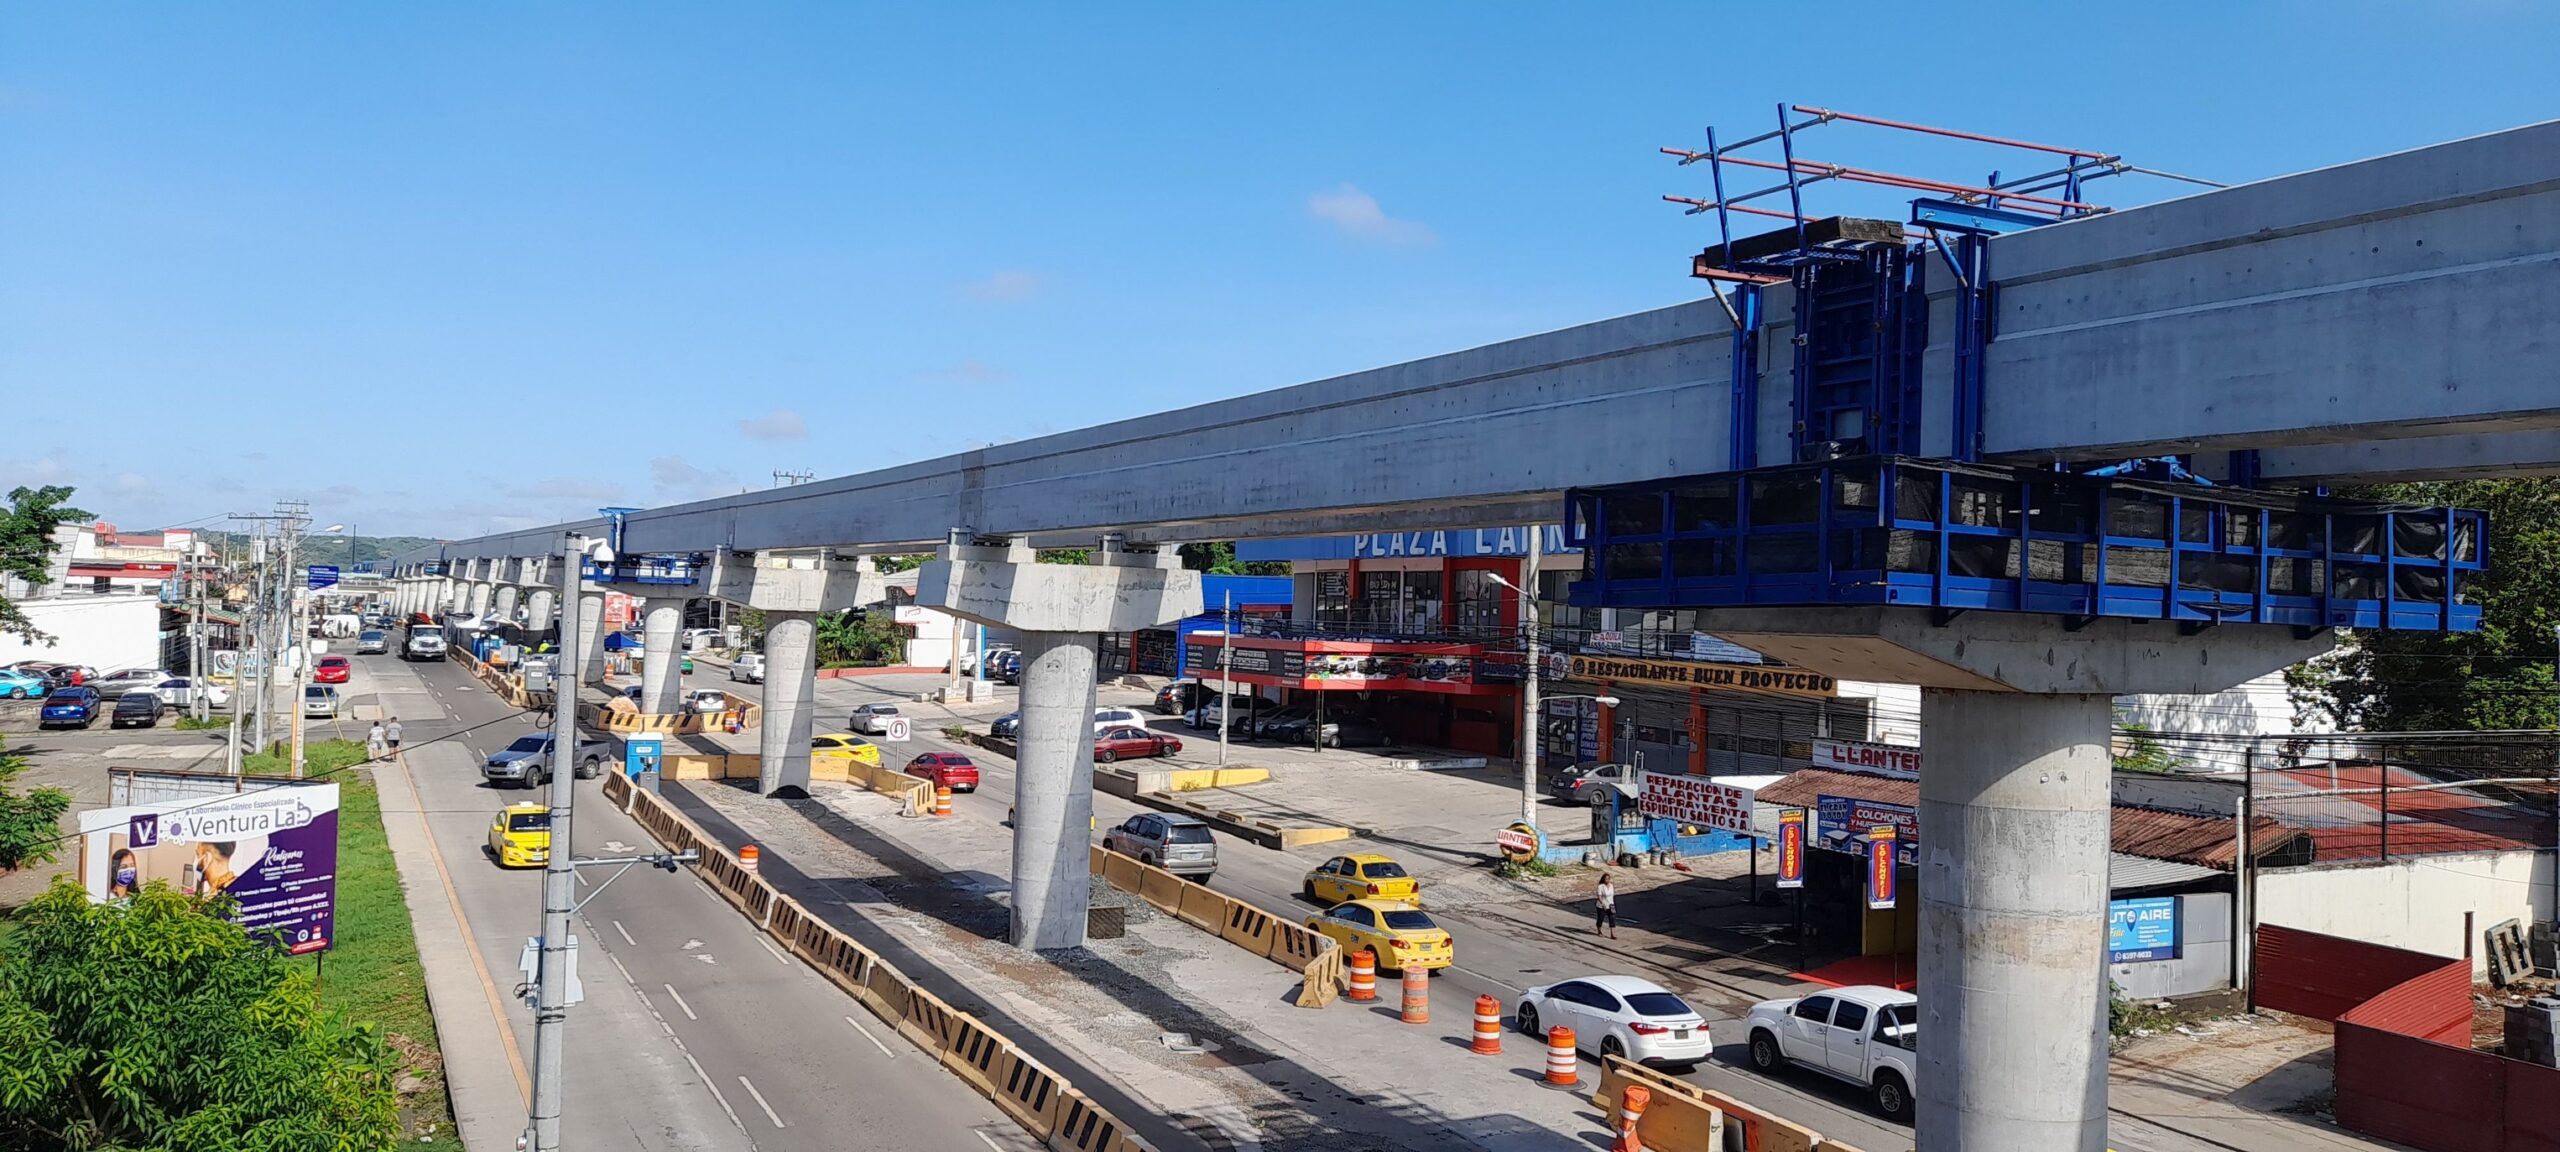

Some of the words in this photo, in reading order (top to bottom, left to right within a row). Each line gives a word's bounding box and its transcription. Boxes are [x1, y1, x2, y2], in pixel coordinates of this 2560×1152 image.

[1354, 530, 1448, 557] PLAZA
[1475, 524, 1586, 554] LAN
[1587, 661, 1687, 682] RESTAURANTE
[1694, 668, 1739, 685] BUEN
[1740, 671, 1833, 692] PROVECHO
[1646, 774, 1721, 795] REPARACION
[1724, 788, 1742, 799] DE
[1648, 785, 1739, 807] LLANTAS
[189, 812, 269, 837] Ventura
[275, 797, 313, 828] Lab
[253, 798, 295, 809] Especializado
[1640, 791, 1693, 809] COMPRA
[1702, 804, 1749, 819] VENTA
[1640, 801, 1687, 819] ESPIRITU
[1690, 810, 1725, 826] SANTO
[1728, 819, 1751, 831] S.A.
[1856, 809, 1912, 825] COLCHONES
[1787, 827, 1795, 877] COLCHONES
[1879, 844, 1887, 897] COLCHONES
[2138, 908, 2171, 921] AIRE
